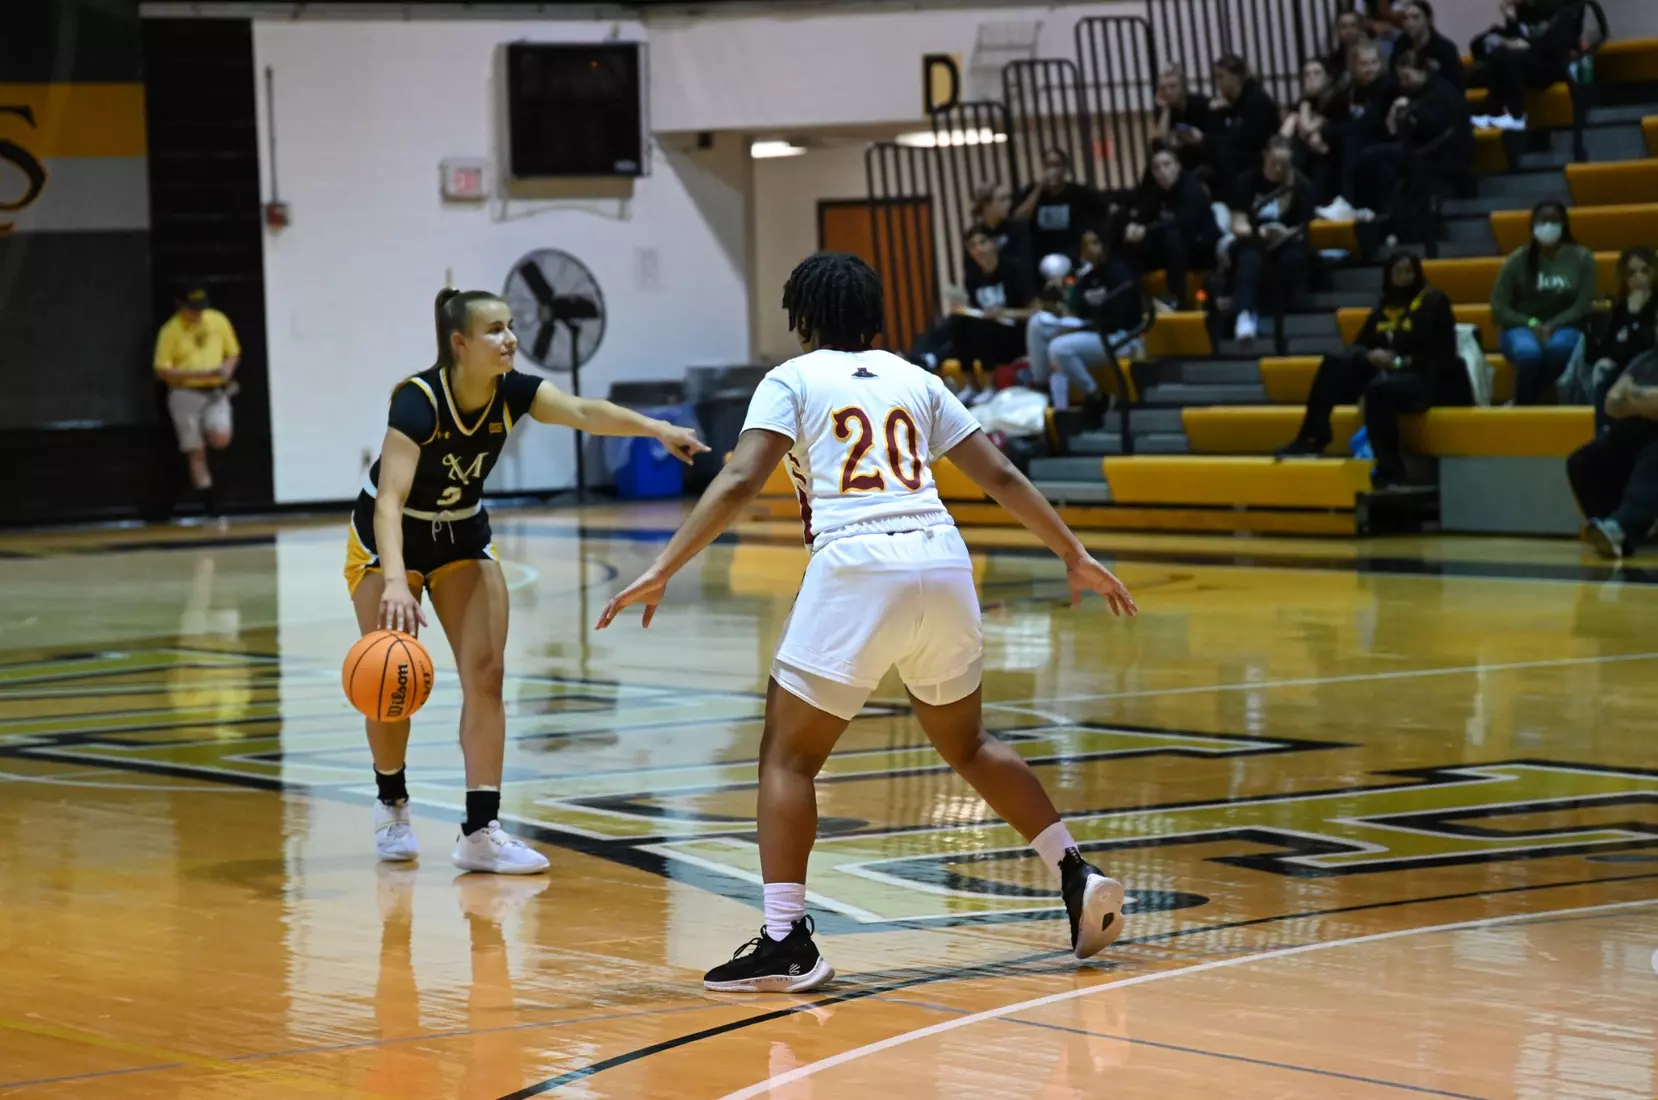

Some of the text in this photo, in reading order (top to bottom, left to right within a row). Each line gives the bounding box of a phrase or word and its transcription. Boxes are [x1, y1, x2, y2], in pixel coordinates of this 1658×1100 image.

[923, 54, 959, 114] D
[442, 452, 489, 485] M
[830, 405, 922, 495] 20
[386, 664, 409, 717] Wilson
